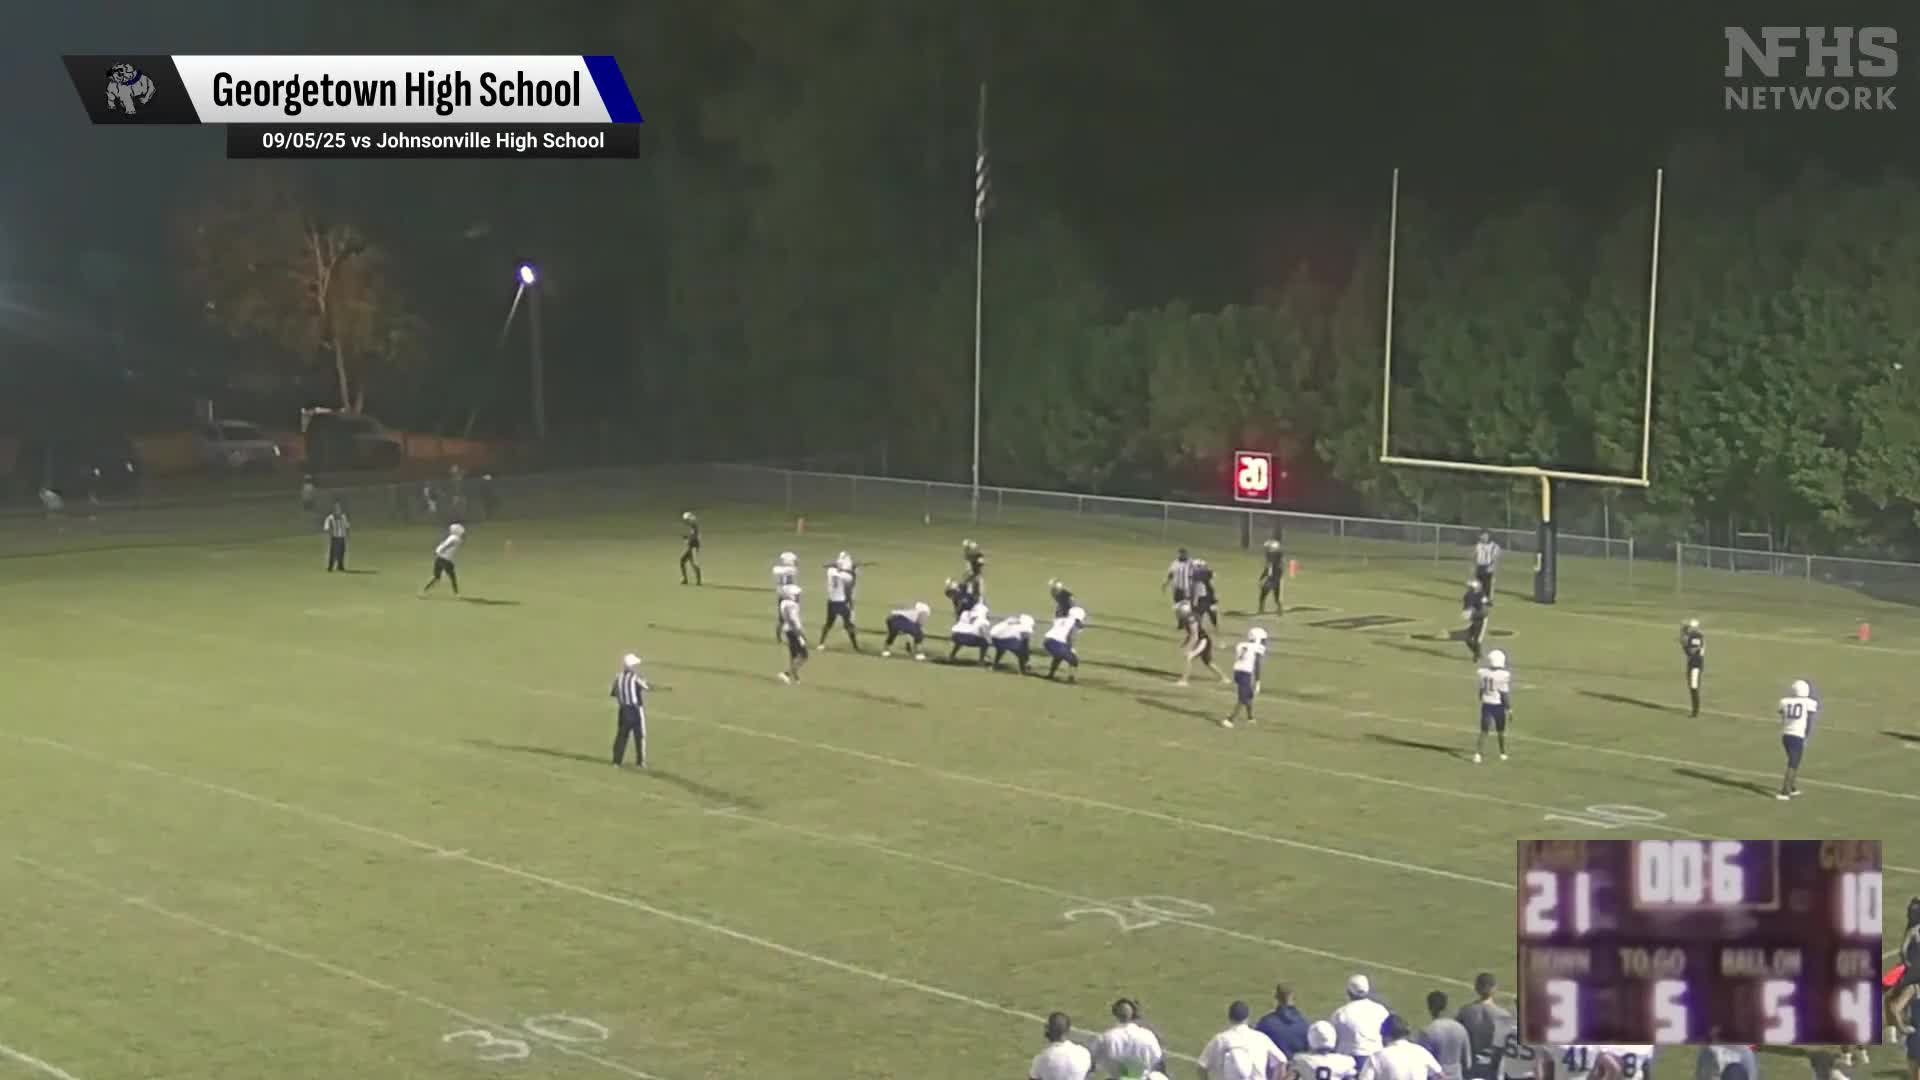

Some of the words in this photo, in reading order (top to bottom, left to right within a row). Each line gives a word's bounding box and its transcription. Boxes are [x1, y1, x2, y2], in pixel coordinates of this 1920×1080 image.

[1786, 703, 1803, 720] 10
[1543, 803, 1668, 829] 10
[1064, 895, 1216, 933] 20
[442, 1013, 609, 1062] 30
[1562, 1046, 1588, 1072] 41
